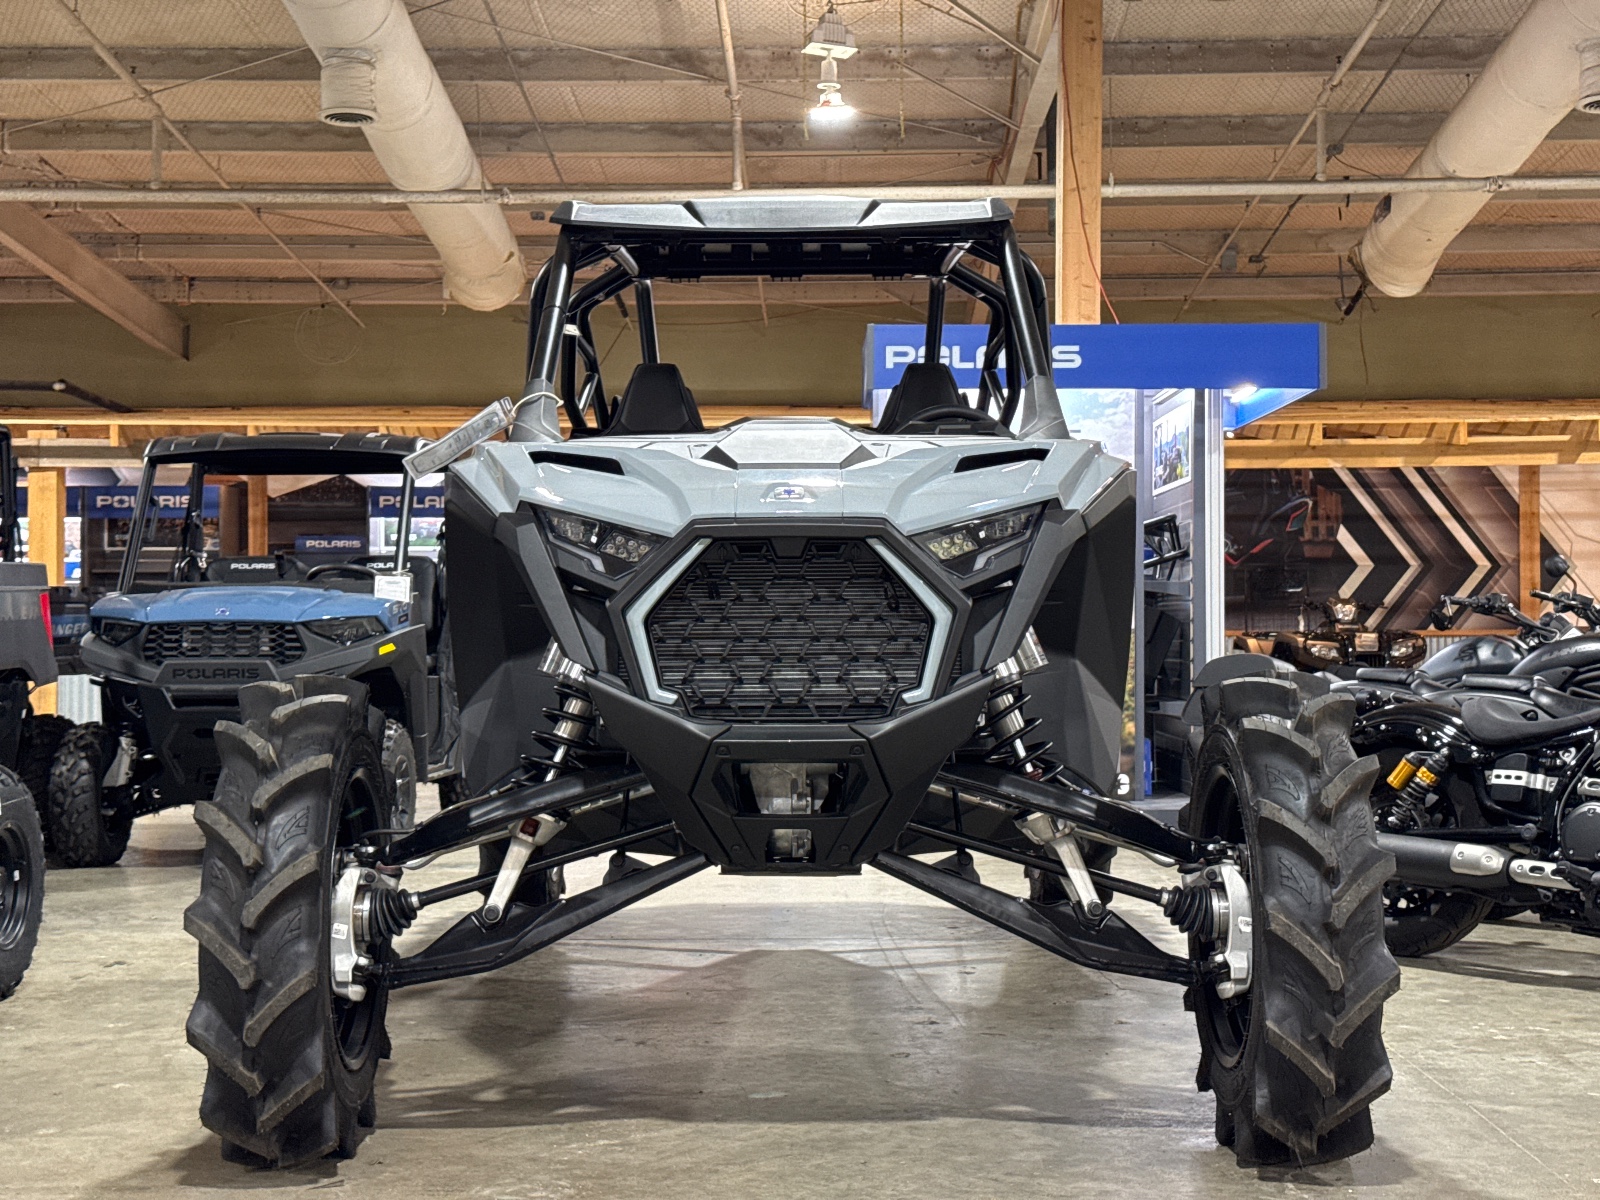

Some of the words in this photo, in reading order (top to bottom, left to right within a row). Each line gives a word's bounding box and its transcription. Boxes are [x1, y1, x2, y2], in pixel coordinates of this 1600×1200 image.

[885, 345, 1082, 369] POLAS
[96, 495, 190, 508] POLRIS
[306, 540, 361, 548] POLARIS
[172, 668, 260, 679] POLARIS
